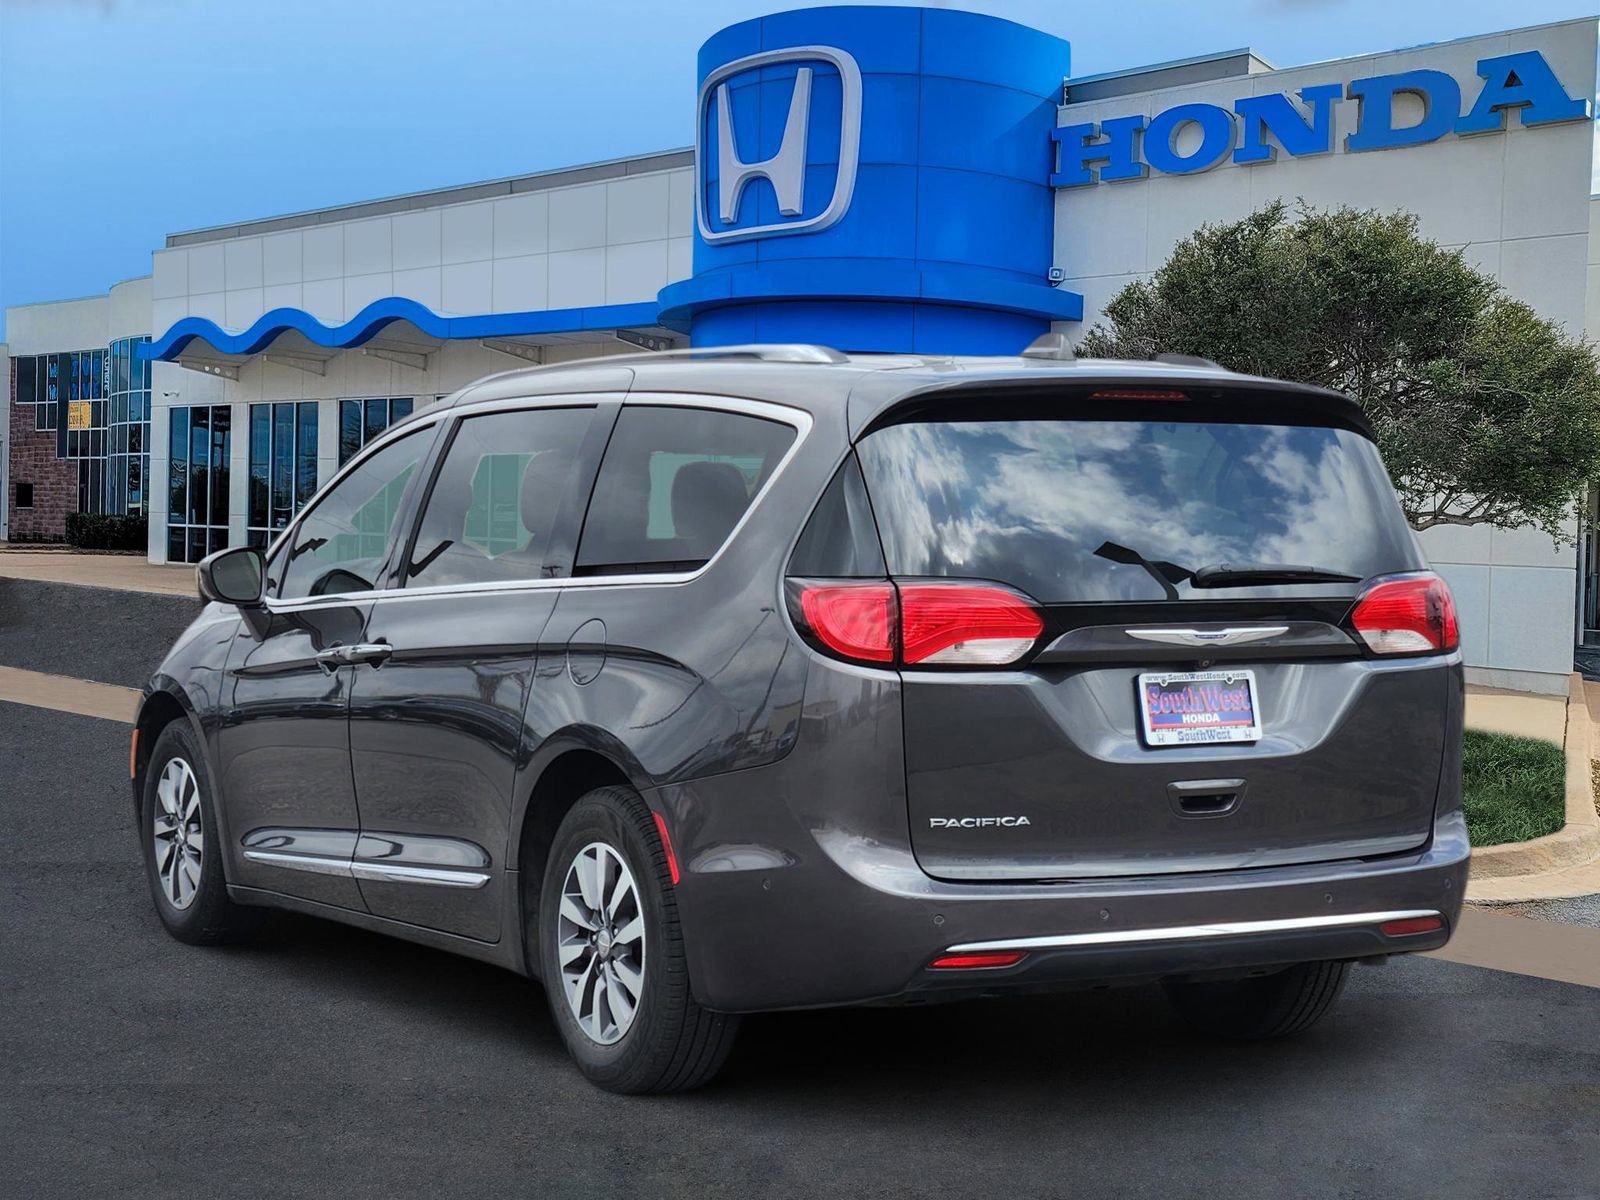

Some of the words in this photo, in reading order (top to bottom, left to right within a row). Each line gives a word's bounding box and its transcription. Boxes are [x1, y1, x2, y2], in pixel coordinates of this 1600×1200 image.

[1050, 49, 1591, 189] HONDA
[1182, 714, 1220, 723] HONDA
[1177, 729, 1232, 742] SouthWest
[929, 816, 1031, 828] PACIFICA
